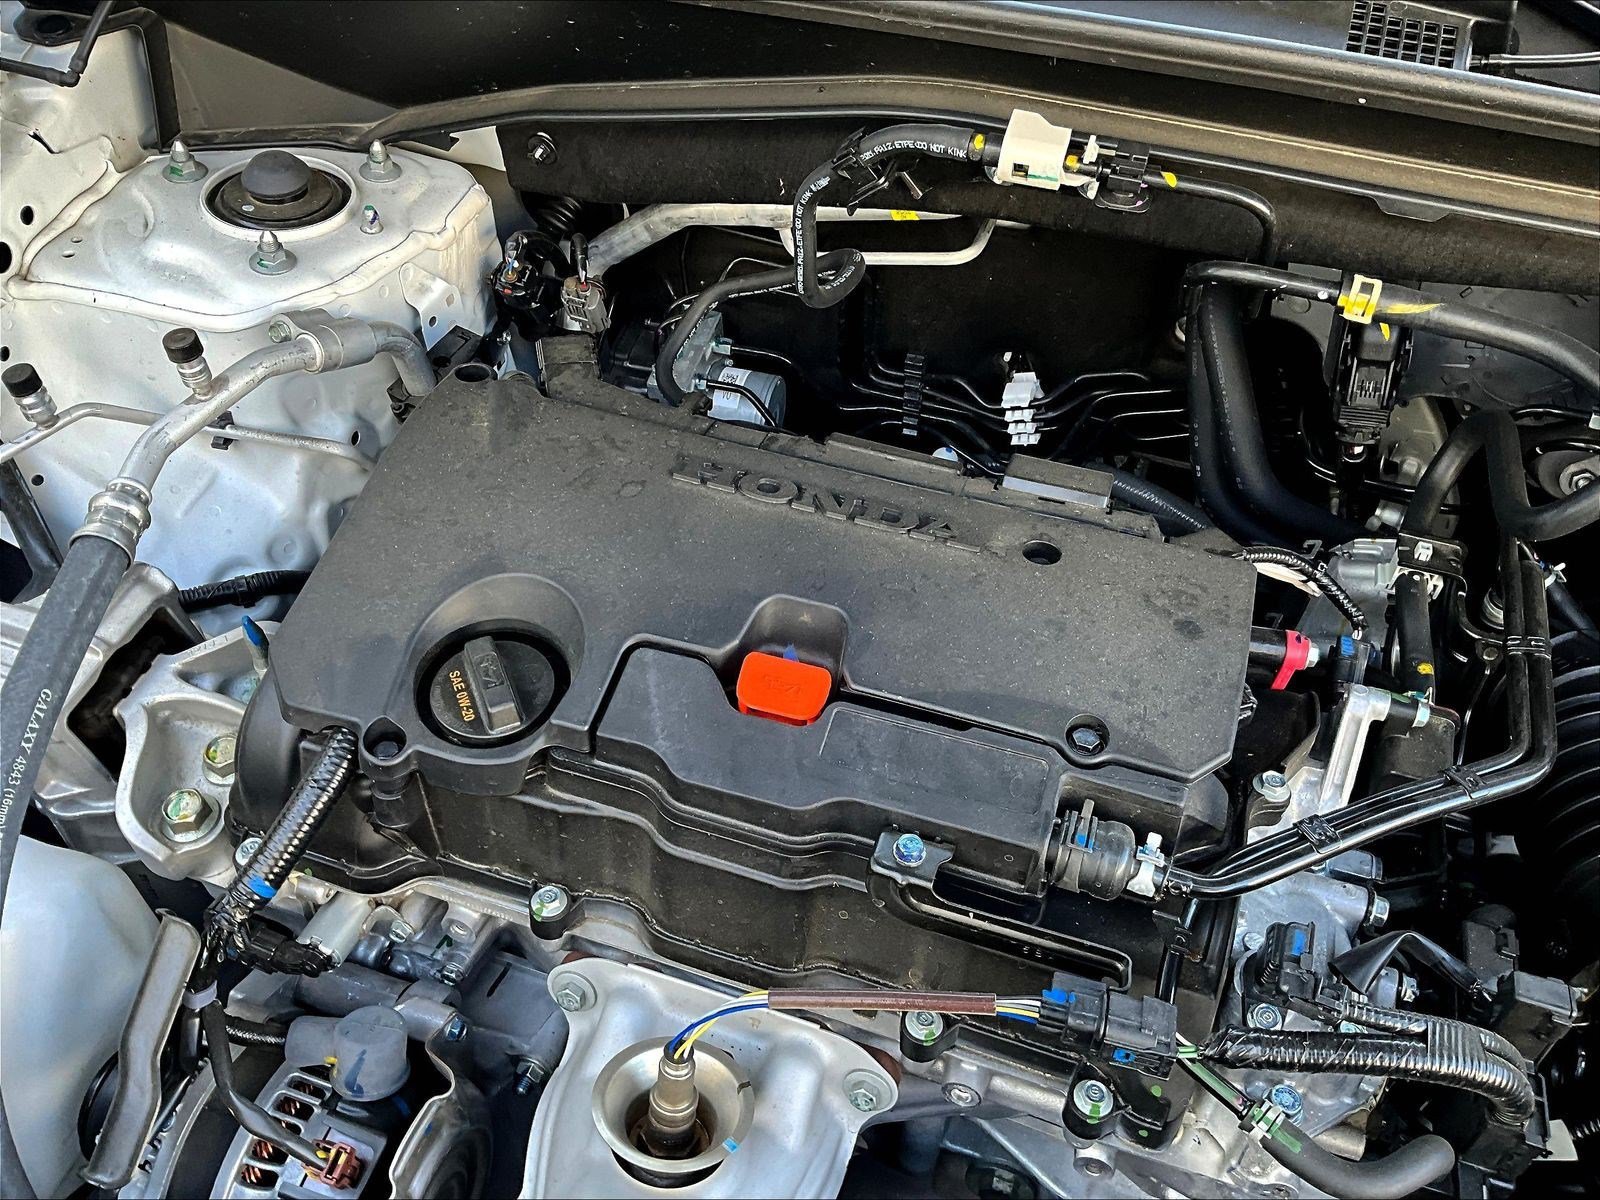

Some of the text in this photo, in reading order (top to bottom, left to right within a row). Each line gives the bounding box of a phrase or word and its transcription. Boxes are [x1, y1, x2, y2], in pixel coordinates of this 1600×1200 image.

[929, 143, 946, 154] NOT
[947, 146, 968, 159] KINK
[799, 189, 814, 205] KINK
[672, 456, 982, 552] HONDA
[449, 670, 475, 722] SAE 0W-20
[20, 688, 52, 756] GALAXY
[8, 755, 27, 786] 4843
